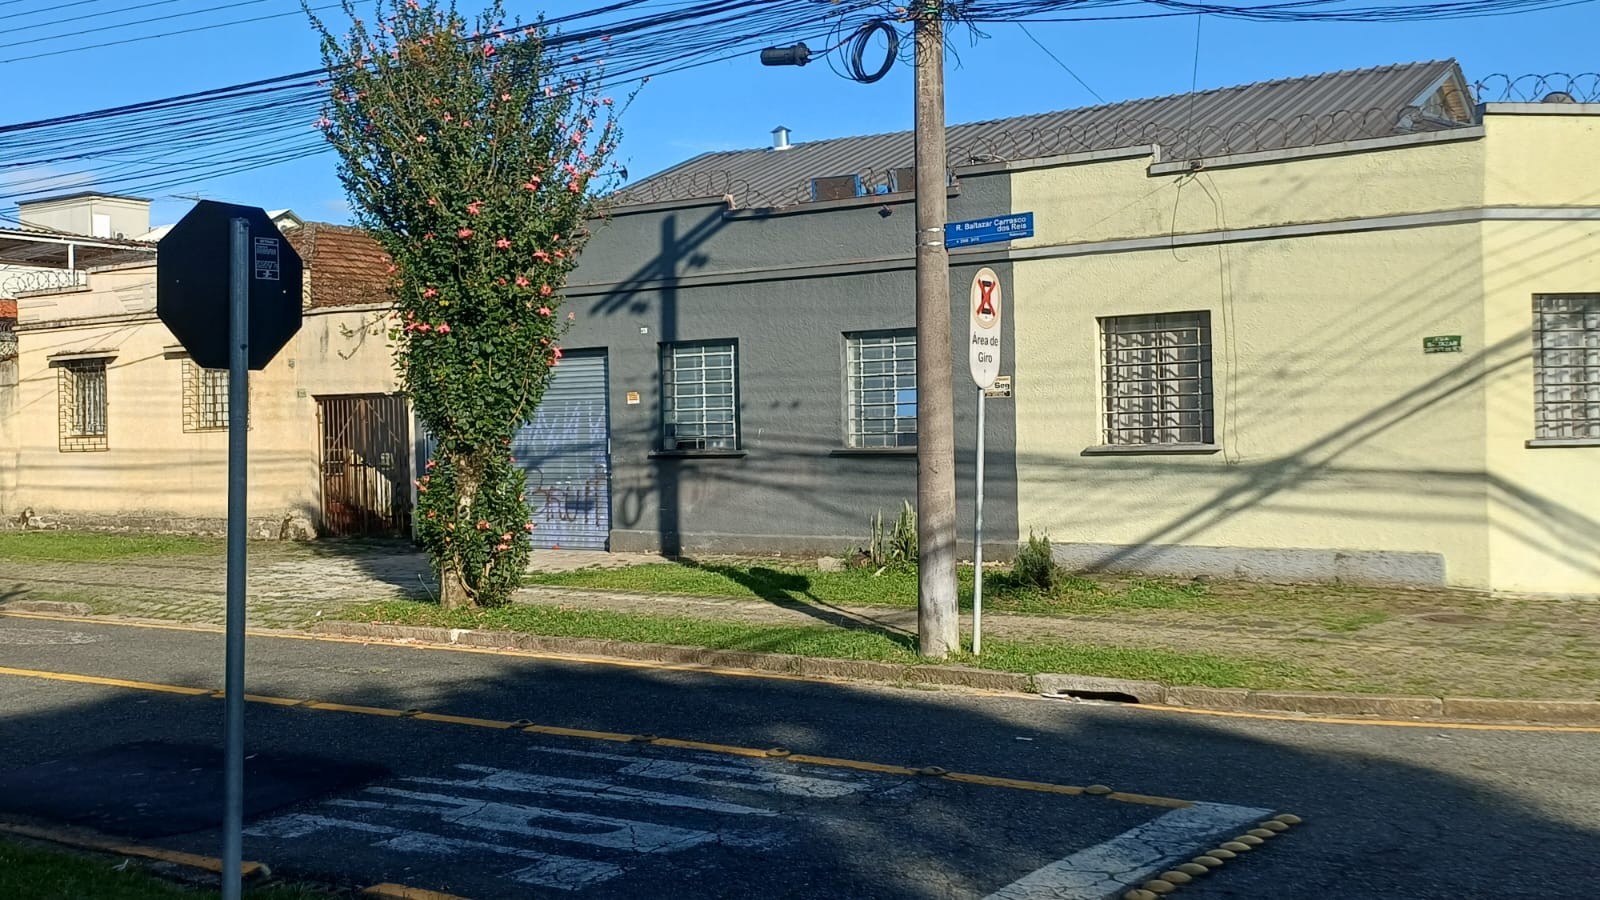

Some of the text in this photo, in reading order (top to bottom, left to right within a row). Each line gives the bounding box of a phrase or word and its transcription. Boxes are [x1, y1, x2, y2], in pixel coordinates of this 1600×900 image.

[964, 221, 992, 230] Baltazar
[993, 217, 1027, 226] Carrasco
[1011, 222, 1027, 230] Reis
[972, 332, 999, 347] Área de
[978, 352, 993, 363] Giro
